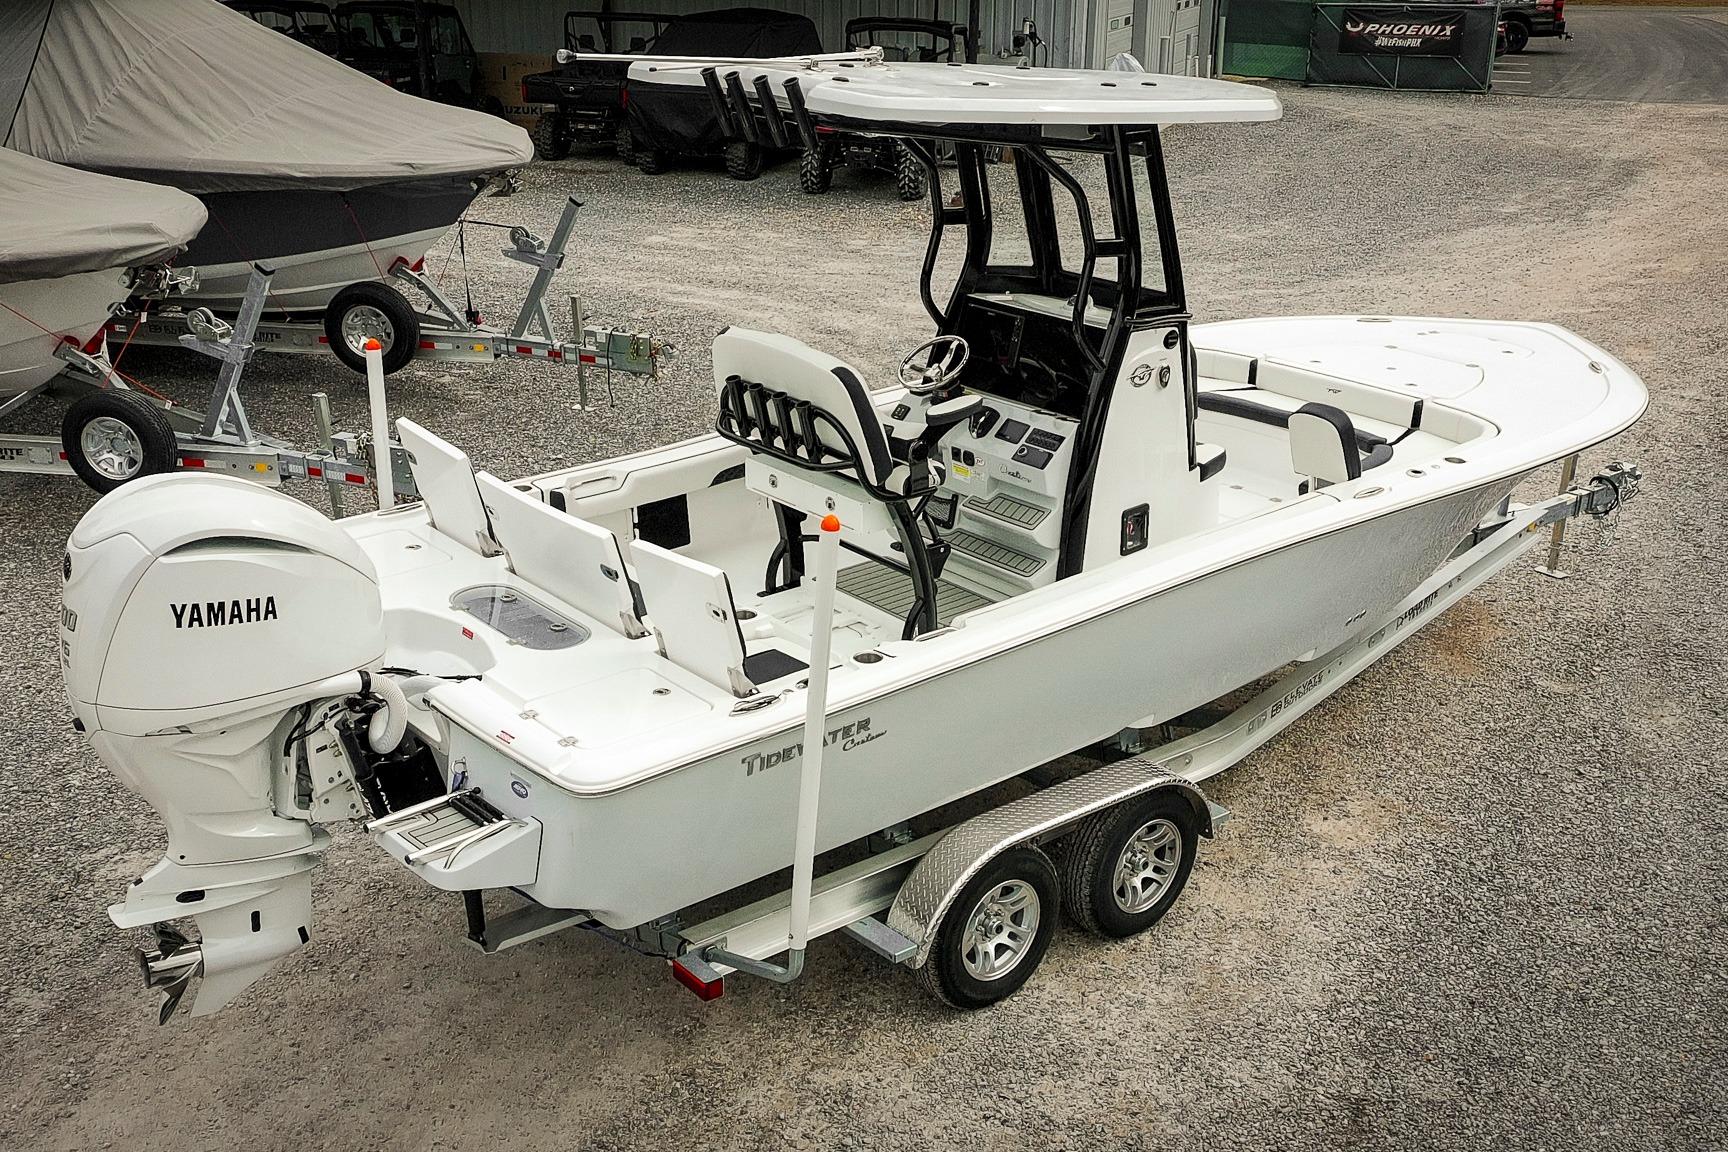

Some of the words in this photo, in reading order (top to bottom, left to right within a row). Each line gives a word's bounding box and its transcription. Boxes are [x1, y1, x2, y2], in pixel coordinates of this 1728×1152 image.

[1363, 23, 1456, 36] PHOENIX
[504, 105, 543, 115] UZUKI
[169, 596, 278, 629] YAMAHA
